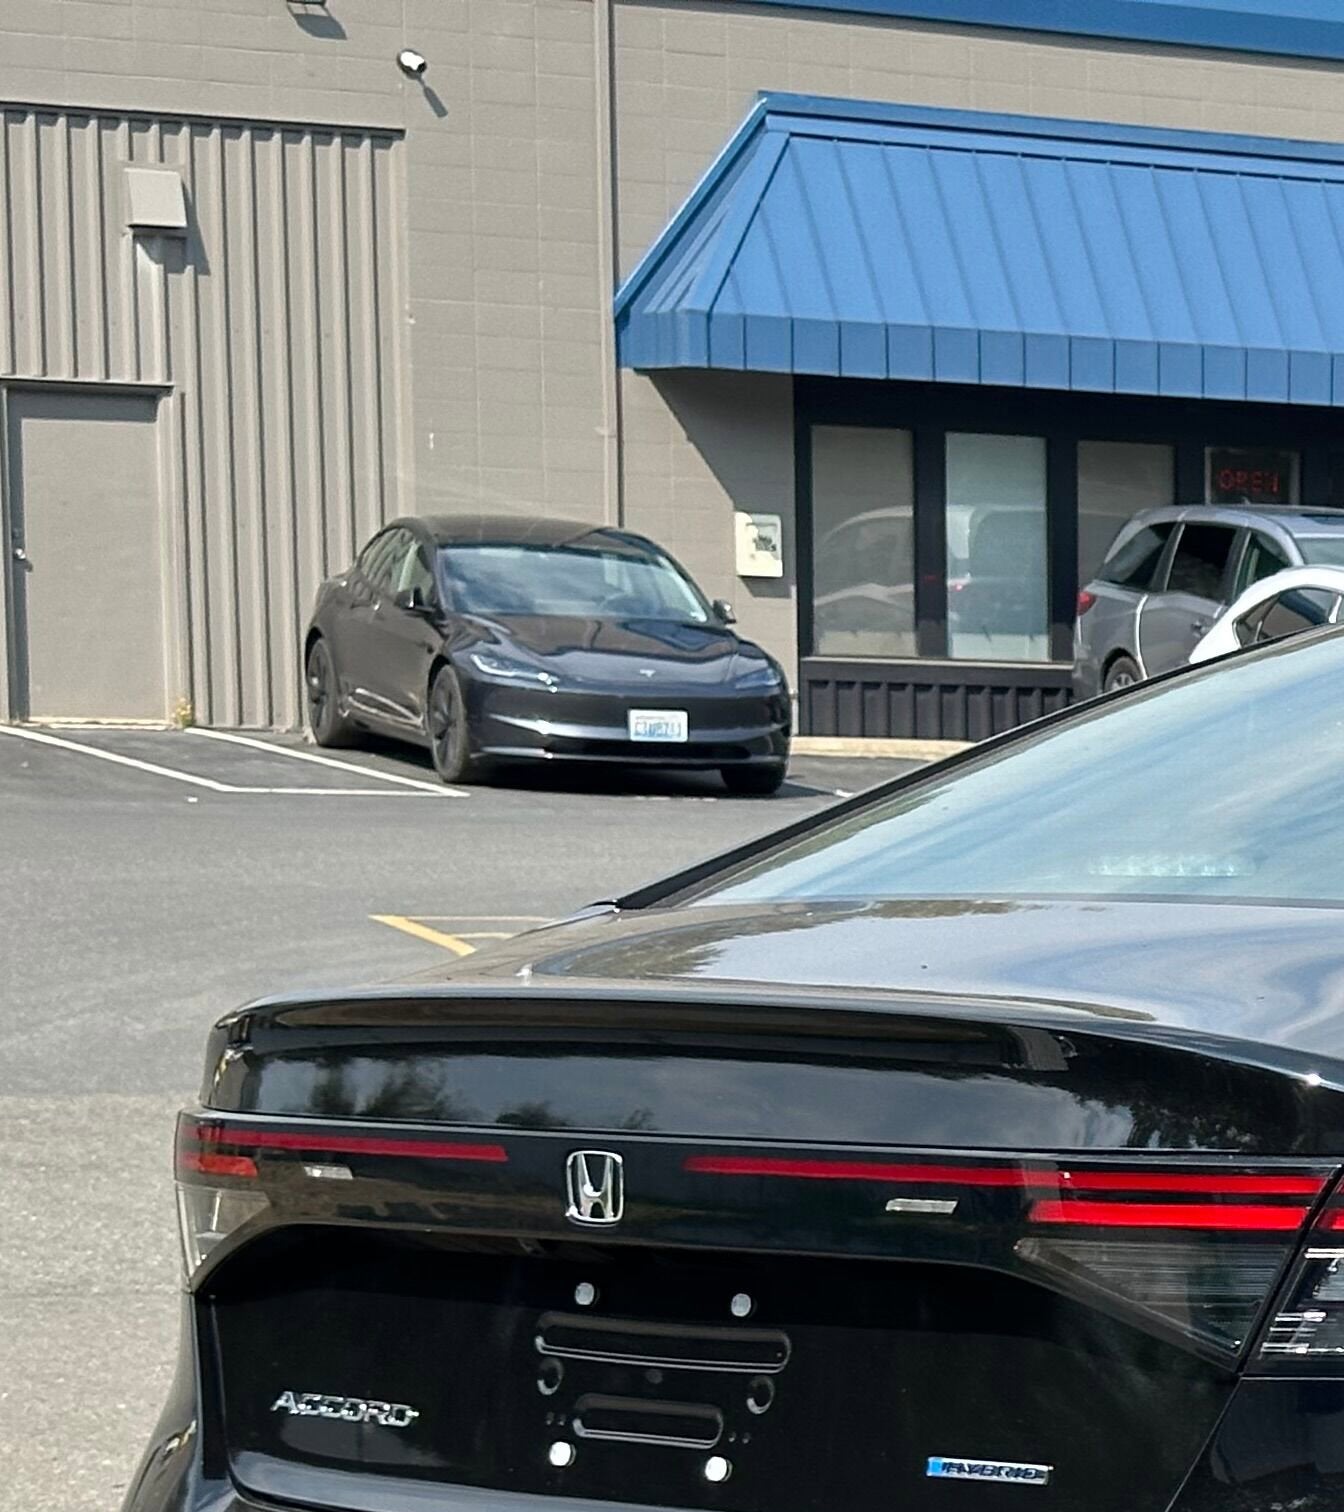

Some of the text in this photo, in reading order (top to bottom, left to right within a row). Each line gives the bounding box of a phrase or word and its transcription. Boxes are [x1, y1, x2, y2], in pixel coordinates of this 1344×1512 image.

[1219, 468, 1280, 493] OPEN
[270, 1390, 420, 1428] ACCORD
[937, 1459, 1047, 1482] HYBRID
